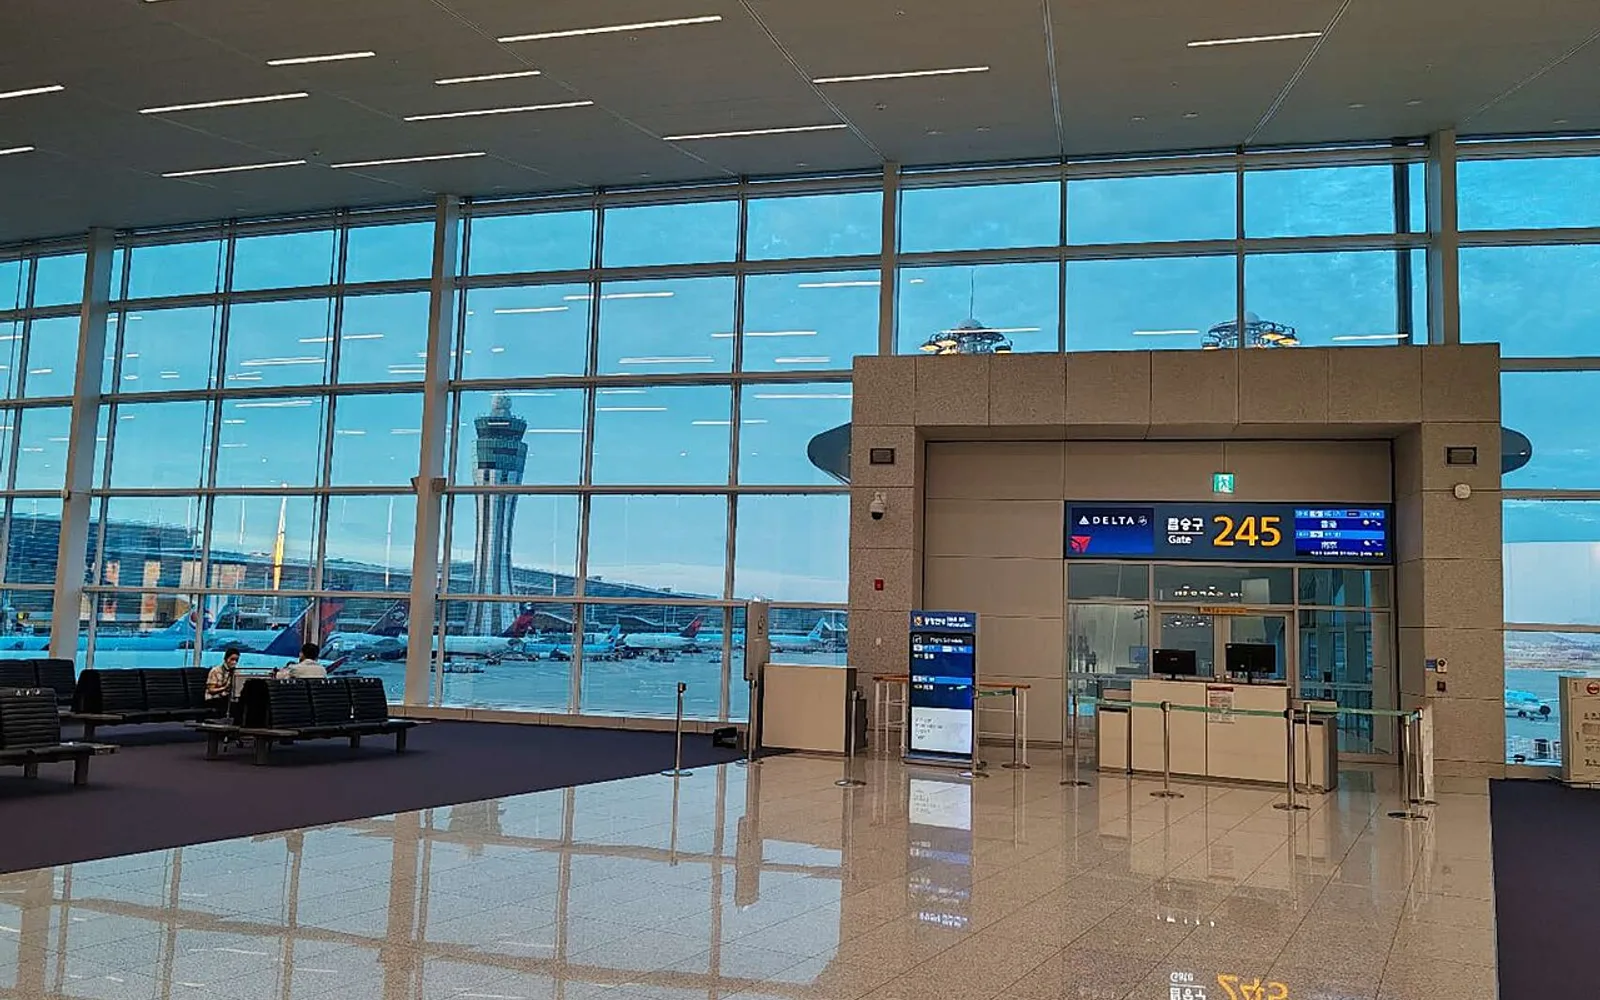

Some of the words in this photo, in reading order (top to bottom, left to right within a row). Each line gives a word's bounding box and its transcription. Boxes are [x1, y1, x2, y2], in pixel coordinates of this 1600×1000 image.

[1093, 516, 1135, 525] DELTA
[1167, 517, 1204, 531] 탑승구
[1213, 516, 1281, 546] 245
[1168, 535, 1192, 544] Gate
